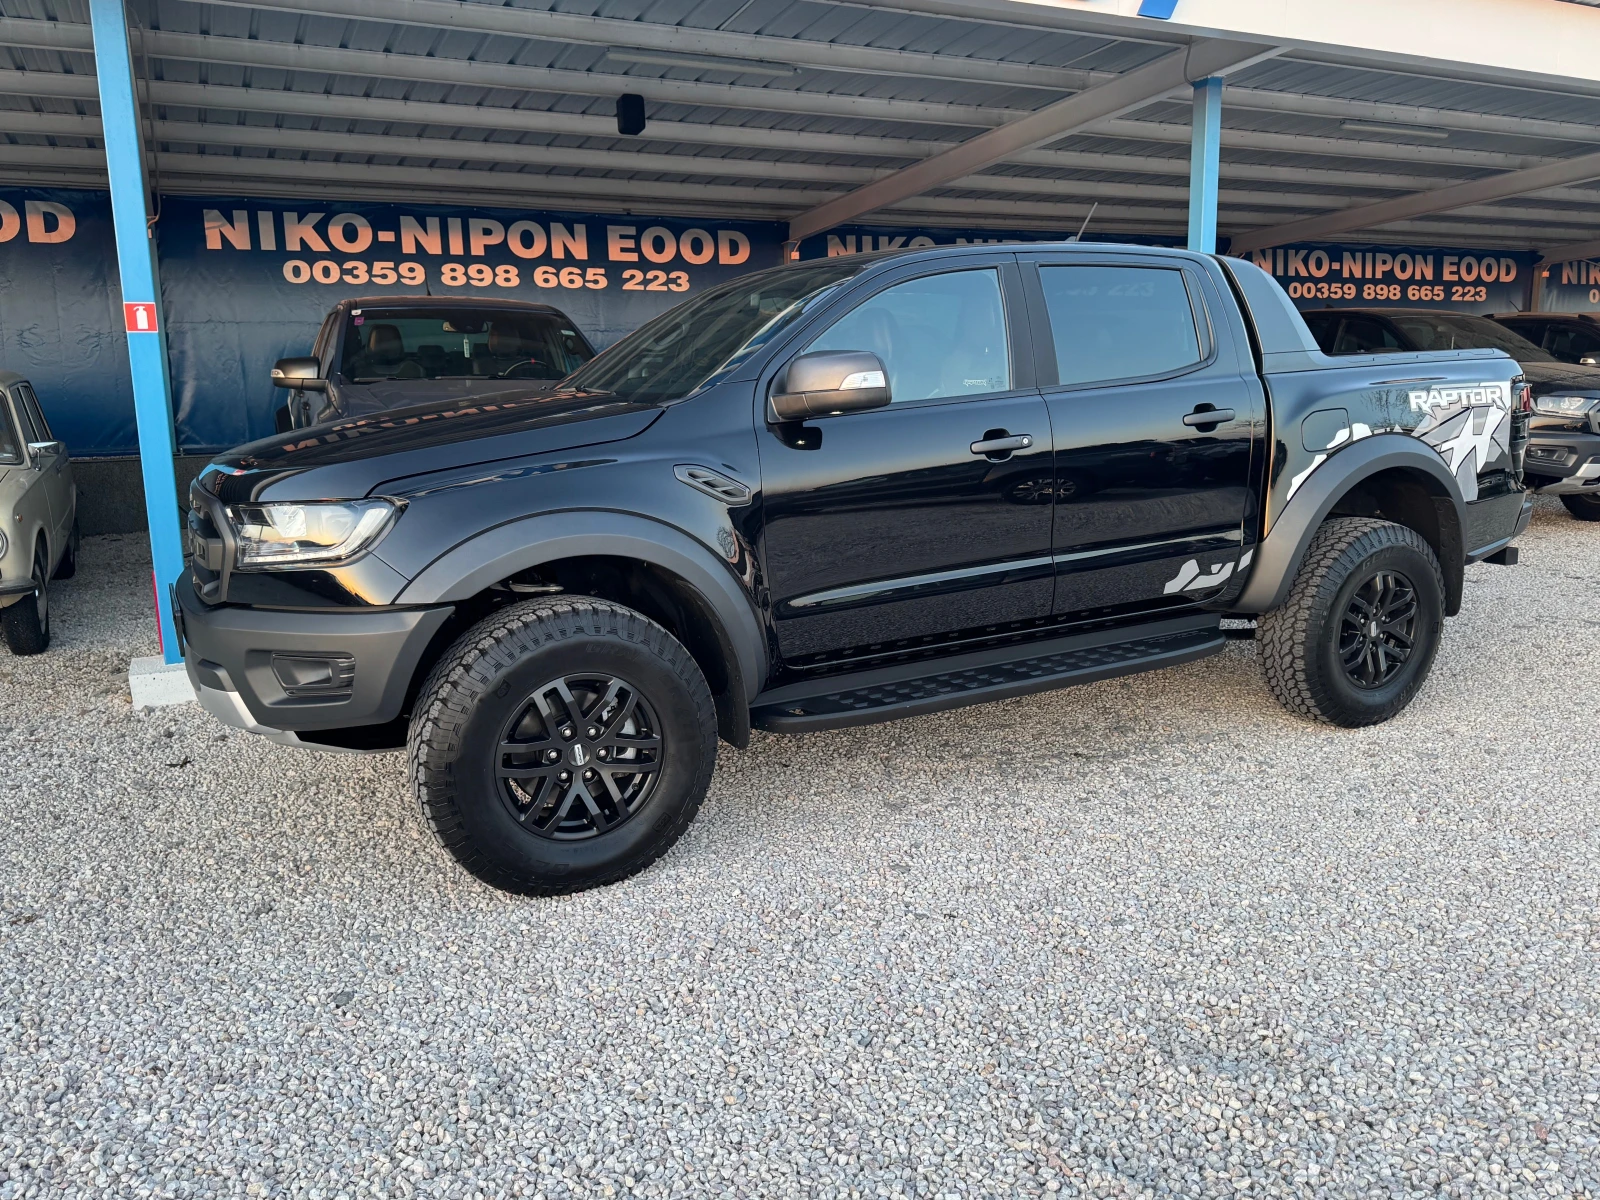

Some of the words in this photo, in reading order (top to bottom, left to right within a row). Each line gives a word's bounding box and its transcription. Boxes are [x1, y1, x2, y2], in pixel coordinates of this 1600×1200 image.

[203, 208, 588, 260] NIKO-NIPON
[606, 224, 751, 266] EOOD
[282, 259, 426, 286] 00359
[440, 263, 521, 288] 898
[533, 265, 609, 290] 665
[621, 268, 691, 293] 223
[1253, 249, 1434, 280] NIKO-NIPON
[1442, 255, 1517, 283] EOOD
[1288, 281, 1357, 300] 00359
[1362, 283, 1402, 301] 898
[1407, 284, 1445, 302] 665
[1451, 286, 1488, 302] 223
[1408, 386, 1508, 421] RAPTOR
